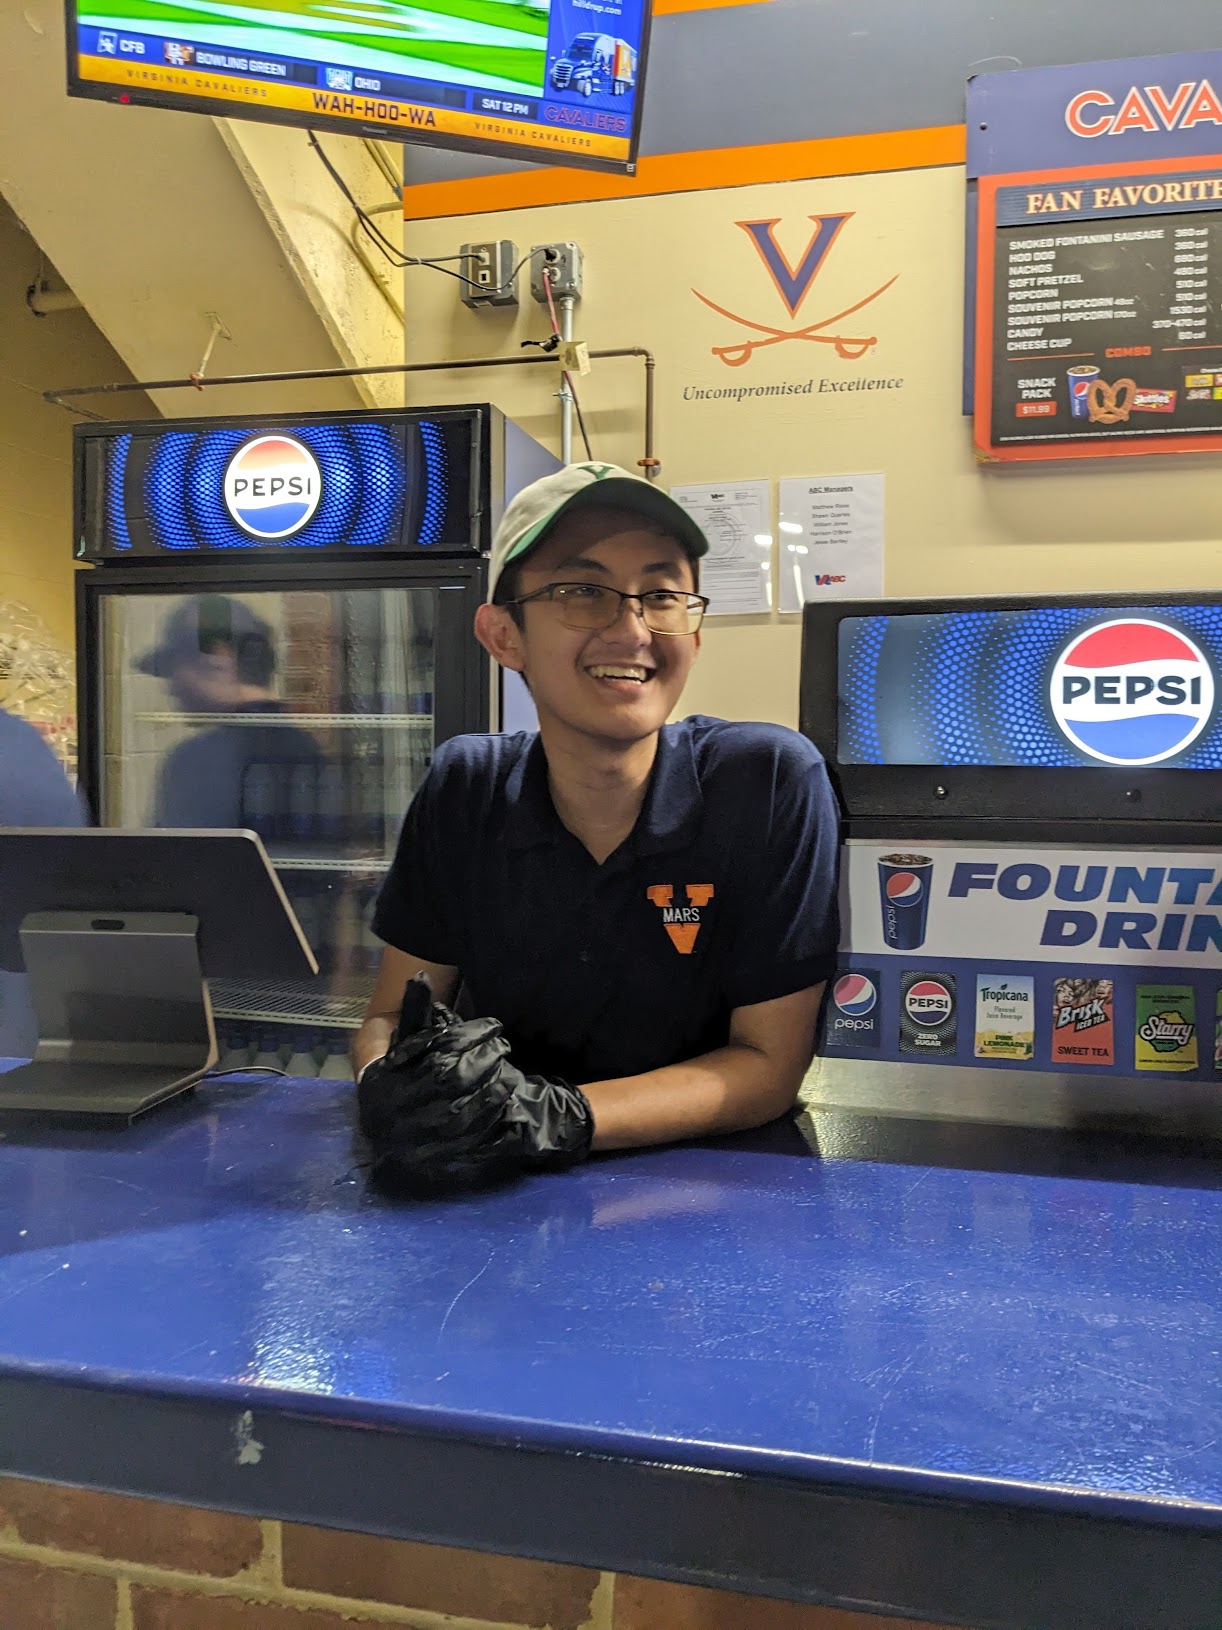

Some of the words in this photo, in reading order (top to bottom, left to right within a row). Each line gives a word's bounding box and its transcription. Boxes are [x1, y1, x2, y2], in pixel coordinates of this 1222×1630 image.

[119, 39, 146, 55] CFB
[196, 50, 248, 71] BOWLING
[249, 60, 287, 77] GREEN
[126, 68, 189, 86] VIRGINIA
[195, 79, 268, 97] CAVALIERS
[354, 76, 381, 92] OHIO
[312, 92, 437, 127] WAH-HOO-WA
[481, 98, 501, 111] SAT
[501, 101, 513, 112] 12
[513, 103, 530, 116] PM
[1065, 78, 1222, 138] CAVA
[544, 104, 628, 134] CAVALIERS
[474, 121, 527, 138] VIRGINIA
[531, 131, 592, 148] CAVALIERS
[1026, 189, 1085, 215] FAN
[1008, 238, 1054, 251] SMOKED
[1055, 233, 1113, 247] FONTANINI
[1113, 229, 1165, 242] SAUSAGE
[1008, 263, 1054, 276] NACHOS
[1007, 277, 1036, 288] SOFT
[1036, 274, 1085, 286] PRETZEL
[1007, 288, 1059, 301] POPCORN
[1007, 301, 1061, 313] SOUVENIR
[1062, 297, 1114, 309] POPCORN
[1007, 313, 1061, 326] SOUVENIR
[1061, 310, 1113, 322] POPCORN
[1006, 327, 1044, 338] CANDY
[1006, 340, 1048, 351] CHEESE
[1048, 338, 1073, 349] CUP
[1105, 346, 1152, 358] COMBO
[683, 378, 814, 402] Uncompromised
[1017, 377, 1057, 389] SNACK
[1021, 388, 1052, 400] PACK
[234, 477, 312, 498] PEPSI
[808, 487, 823, 495] ABC
[1062, 675, 1203, 706] PEPSI
[947, 862, 1222, 906] FOUNT
[662, 907, 701, 923] MARS
[885, 904, 898, 940] pepsi
[980, 986, 1029, 1003] Tropicana
[908, 997, 949, 1010] PEPSI
[834, 1018, 875, 1032] pepsi
[1139, 1015, 1194, 1046] Starry
[913, 1039, 942, 1047] SUGAR
[916, 1032, 939, 1040] ZERO
[983, 1040, 1025, 1048] LEMONADE
[994, 1034, 1014, 1042] PINK
[1057, 1046, 1090, 1056] SWEET
[1091, 1047, 1109, 1057] TEA
